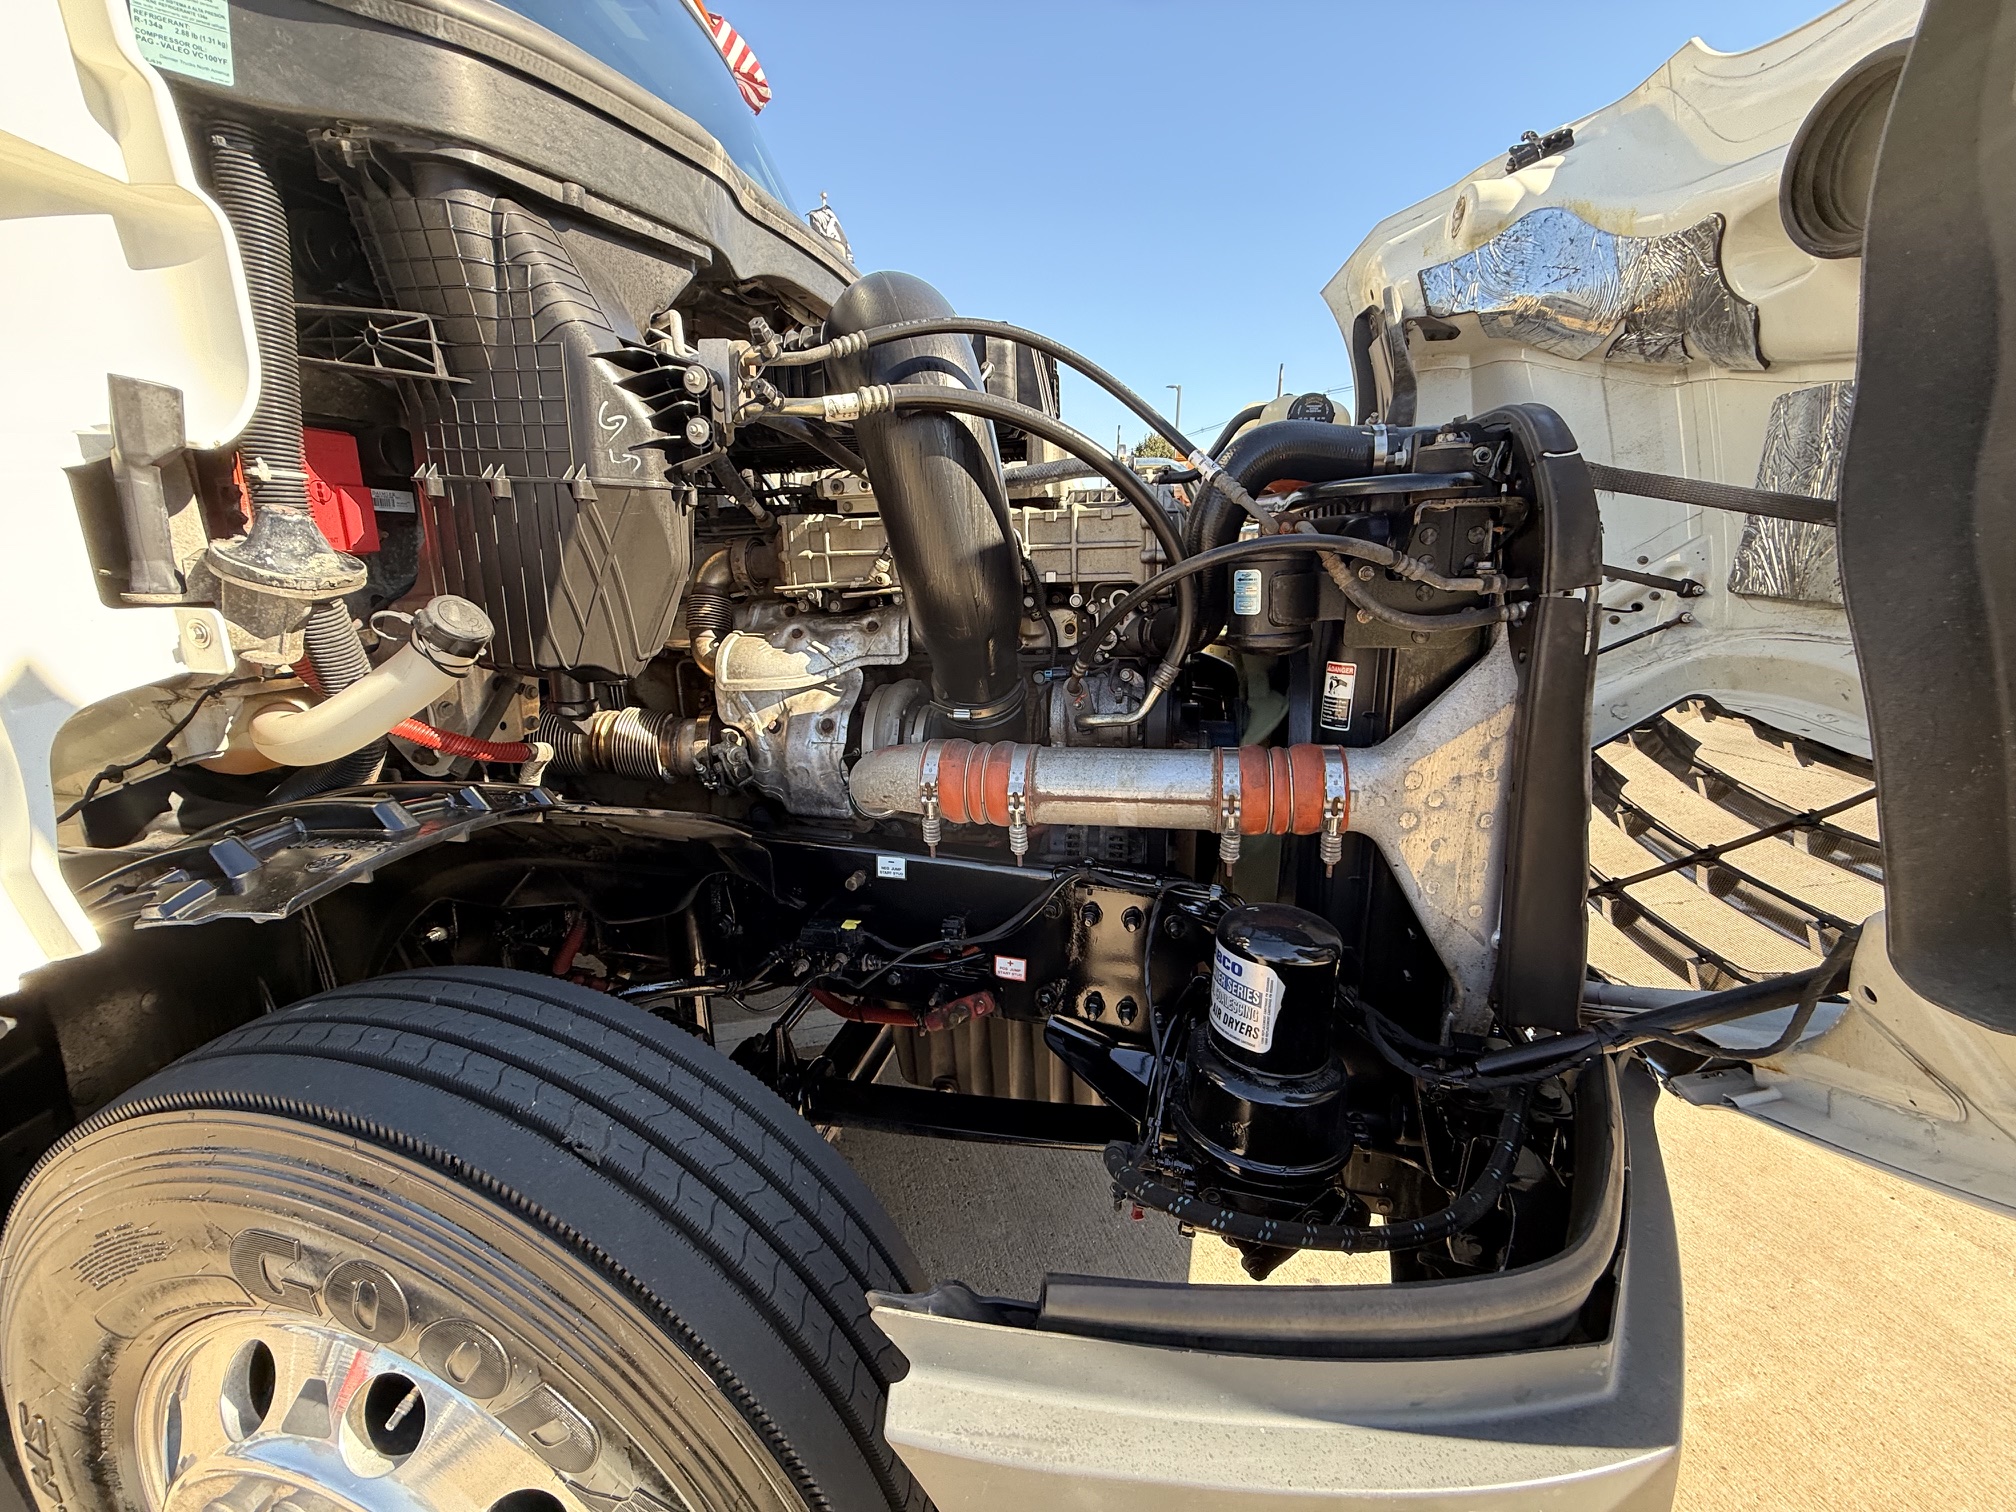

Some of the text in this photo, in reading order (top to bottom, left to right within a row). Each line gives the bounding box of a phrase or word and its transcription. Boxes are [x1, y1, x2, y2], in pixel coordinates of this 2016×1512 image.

[133, 8, 191, 30] REFRIGERANT:
[134, 16, 163, 30] R-134a
[175, 28, 190, 39] 2.88
[199, 33, 215, 45] (1.31
[217, 38, 228, 49] kg)
[134, 27, 191, 47] COMPRESSOR
[135, 34, 154, 45] PAG
[160, 41, 190, 55] VALEO
[192, 50, 228, 65] VC100YF
[1332, 665, 1354, 675] DANGER
[1216, 949, 1243, 977] BCO
[1227, 978, 1260, 1005] SERIES
[1223, 1013, 1260, 1040] DRYERS
